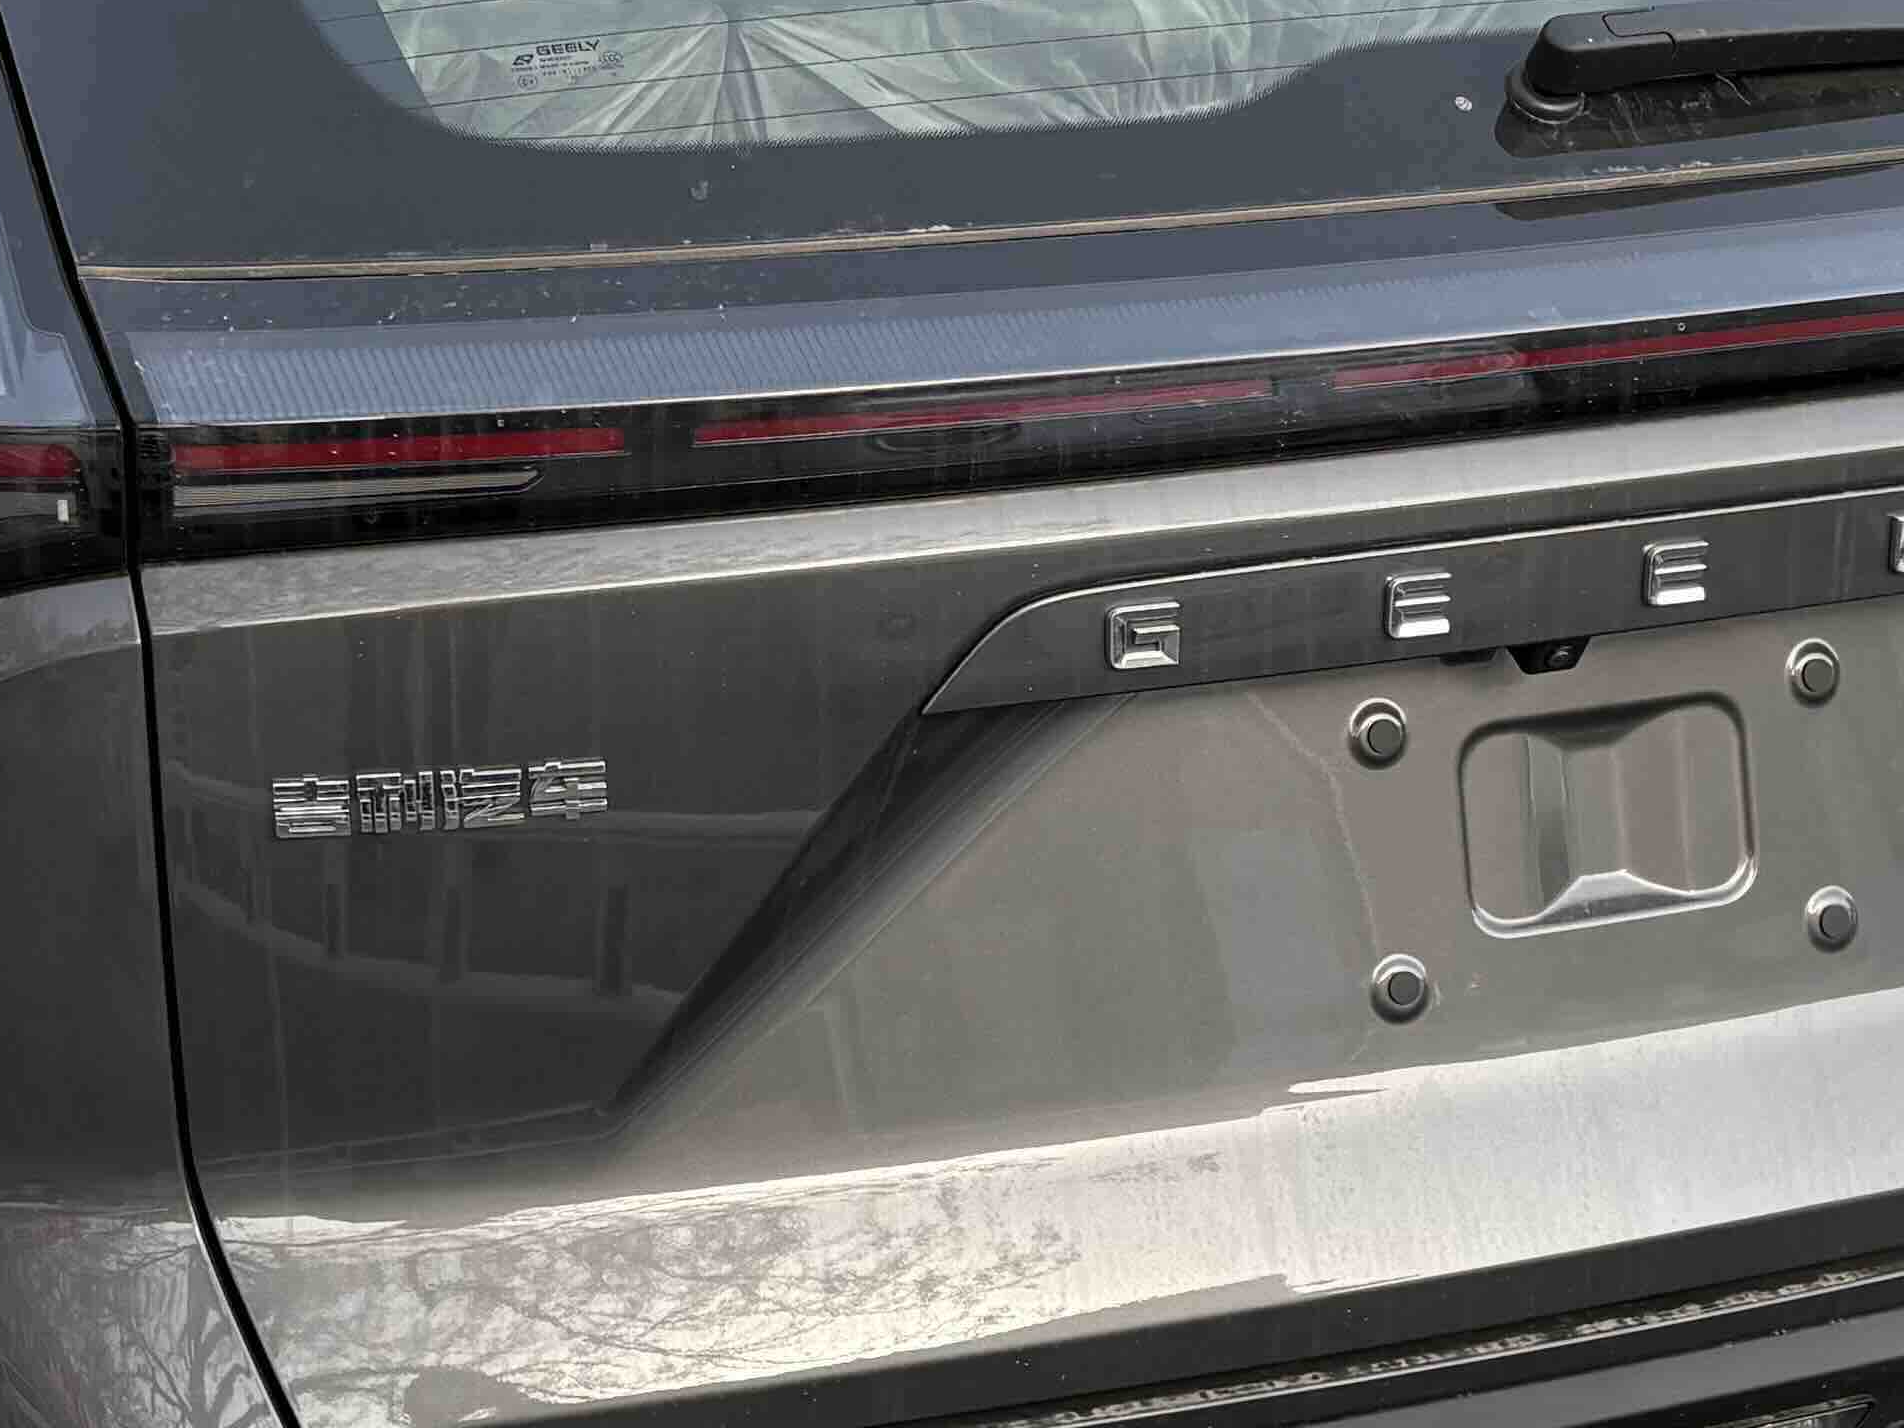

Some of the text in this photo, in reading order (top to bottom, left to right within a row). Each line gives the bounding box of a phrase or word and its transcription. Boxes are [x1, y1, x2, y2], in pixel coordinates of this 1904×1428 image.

[536, 37, 600, 56] GEELY
[271, 756, 608, 839] 吉利汽车
